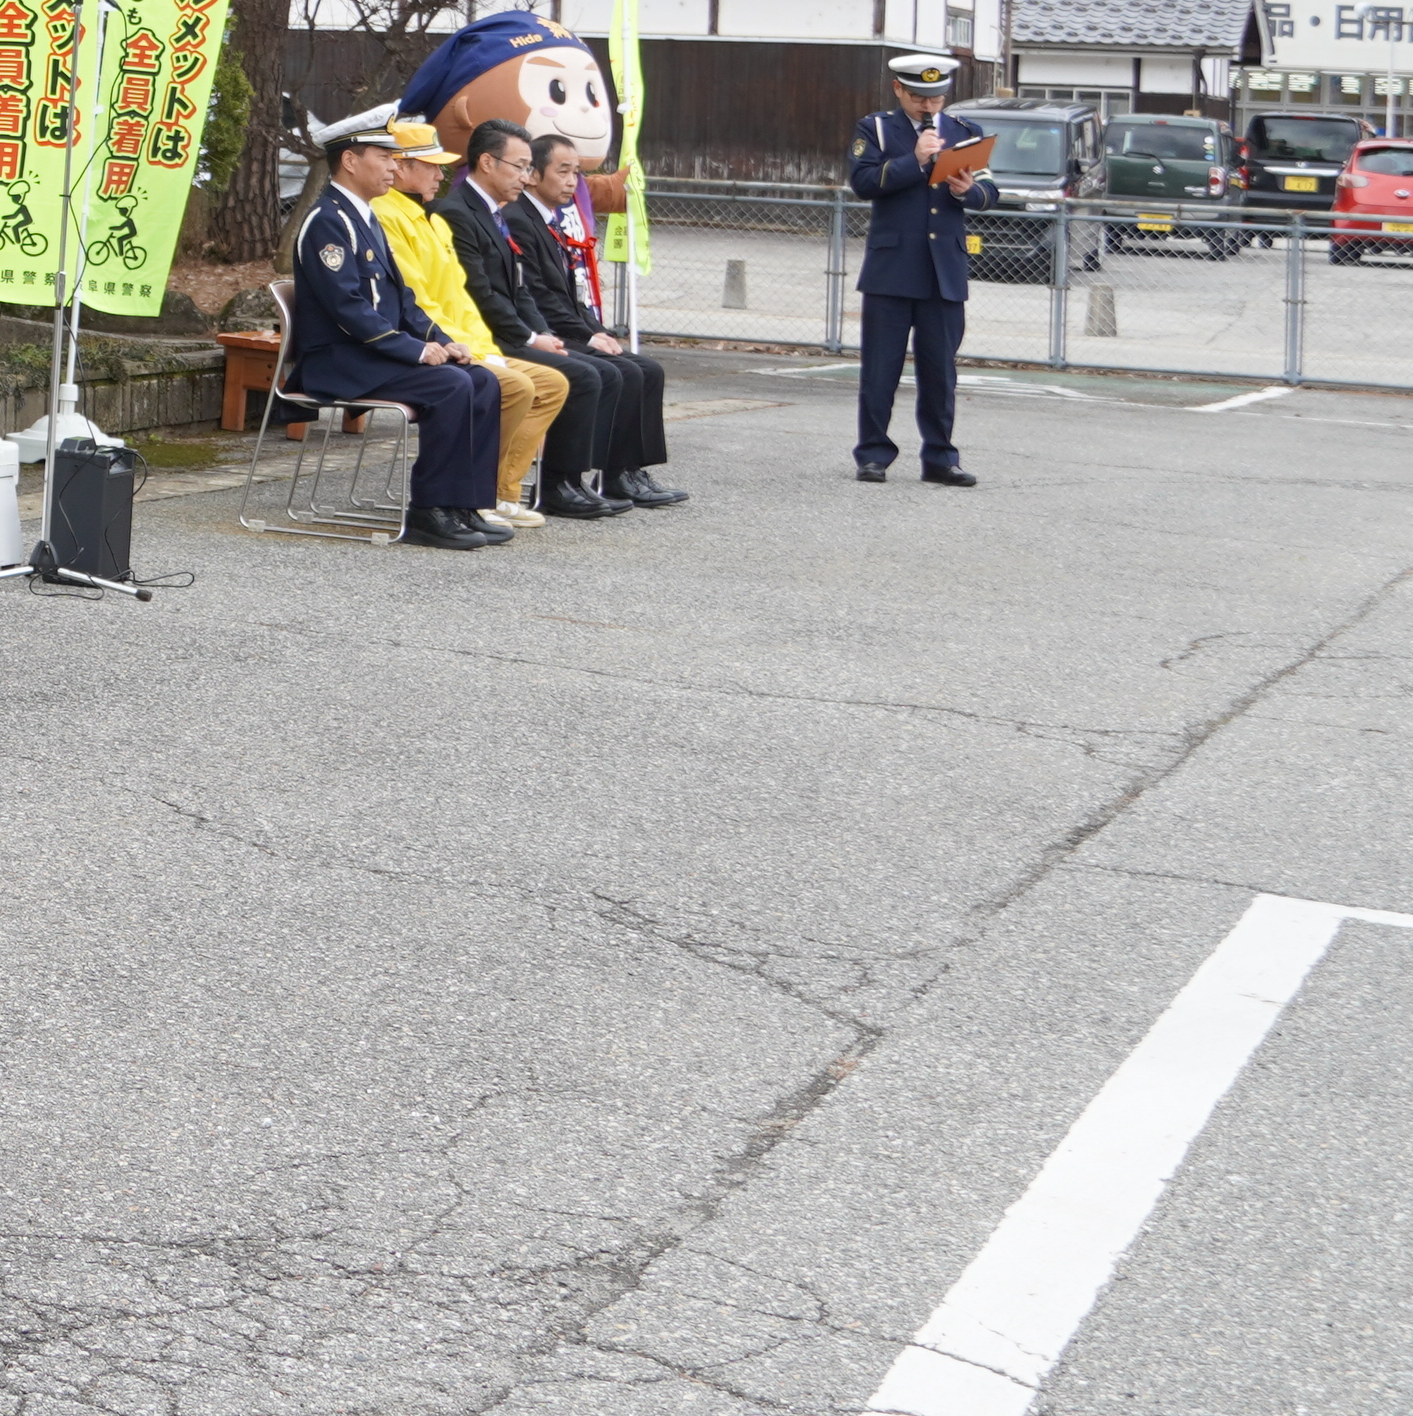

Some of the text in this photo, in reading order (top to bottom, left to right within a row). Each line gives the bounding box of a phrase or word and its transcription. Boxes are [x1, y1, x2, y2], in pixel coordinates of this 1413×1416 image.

[509, 33, 544, 49] Hida
[99, 30, 163, 199] 全員着用
[80, 279, 152, 298] 阜県警察
